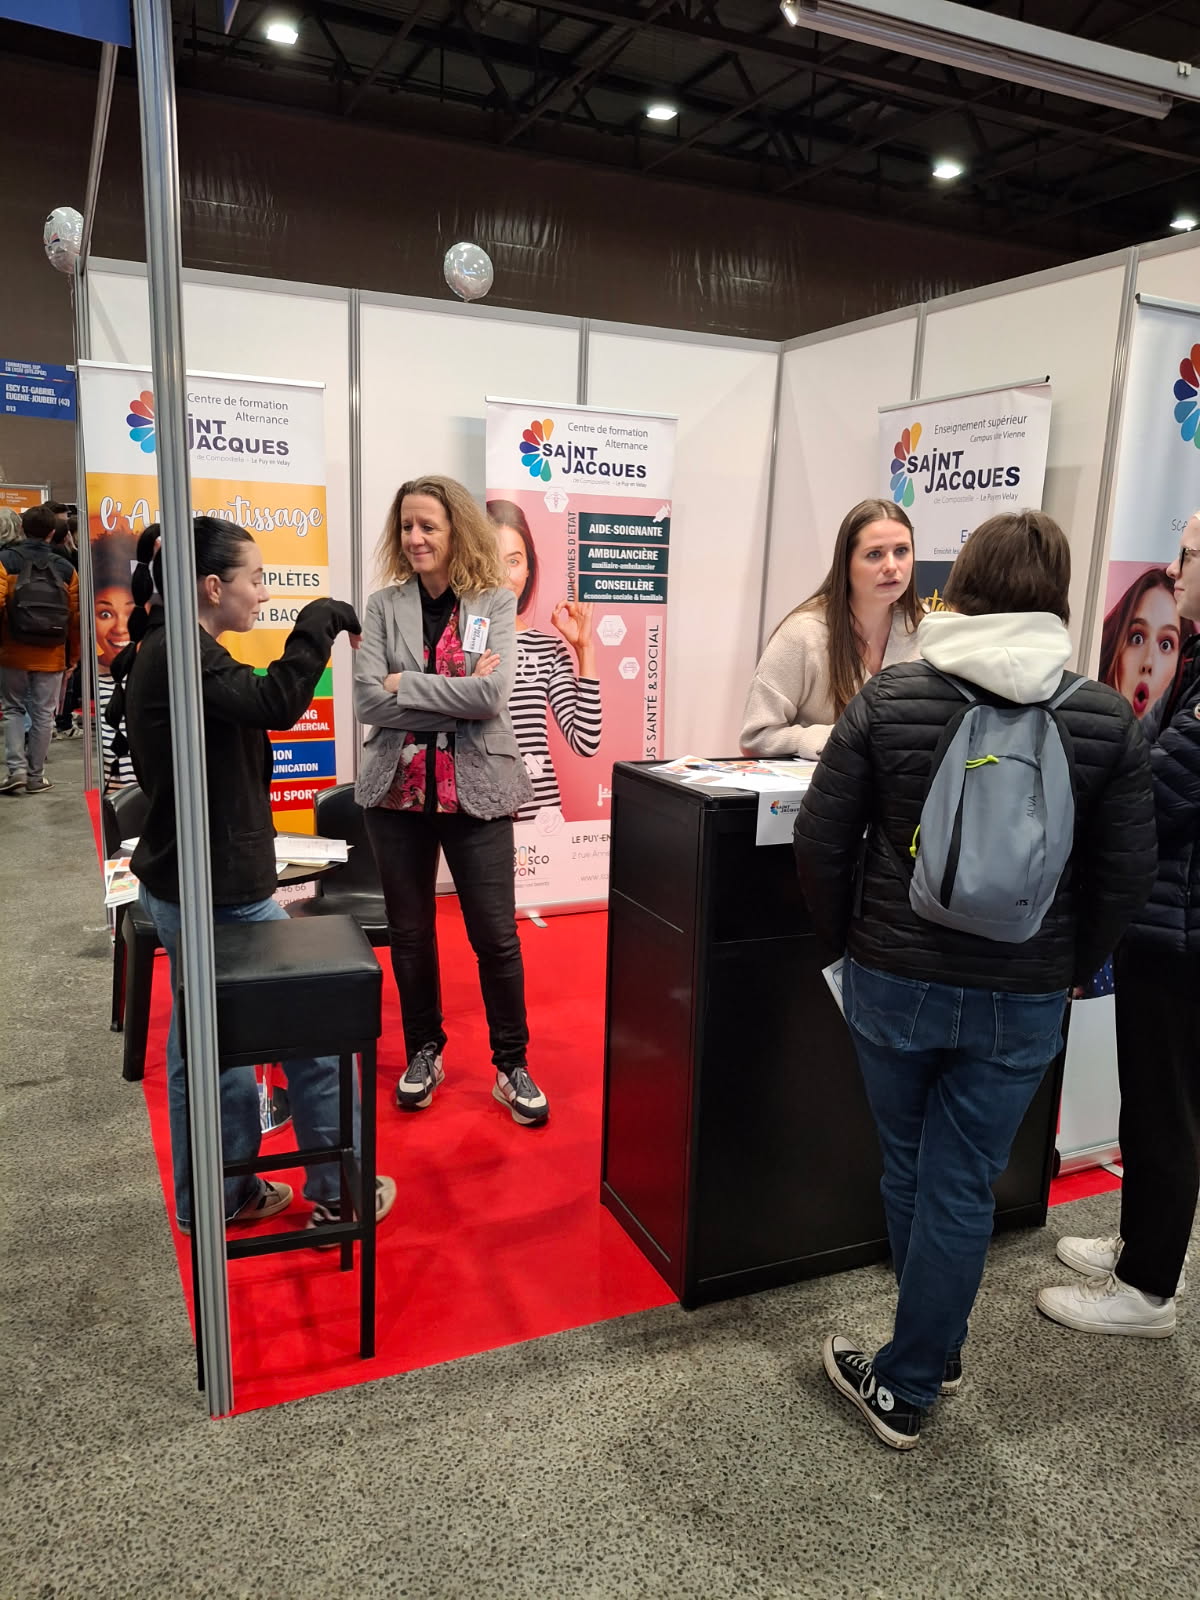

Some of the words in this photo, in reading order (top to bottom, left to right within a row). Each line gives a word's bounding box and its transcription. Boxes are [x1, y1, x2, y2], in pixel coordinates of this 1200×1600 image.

[187, 392, 222, 405] Centre
[224, 396, 237, 406] de
[239, 396, 289, 410] formation
[235, 411, 289, 425] Alternance
[934, 418, 986, 435] Enseignement
[987, 414, 1028, 429] supérieur
[567, 422, 595, 434] Centre
[597, 425, 608, 434] de
[609, 426, 649, 438] formation
[970, 434, 993, 444] Campus
[1003, 429, 1026, 440] Vienne
[605, 439, 649, 451] Alternance
[562, 459, 648, 479] JACQUES
[925, 466, 1021, 494] JACQUES
[588, 523, 664, 537] AIDE-SOIGNANTE
[588, 547, 659, 561] AMBULANCIÈRE
[595, 578, 655, 591] CONSEILLÈRE
[648, 624, 659, 679] SOCIAL
[648, 681, 657, 690] &
[644, 695, 657, 741] SANTÉ
[572, 835, 582, 844] LE
